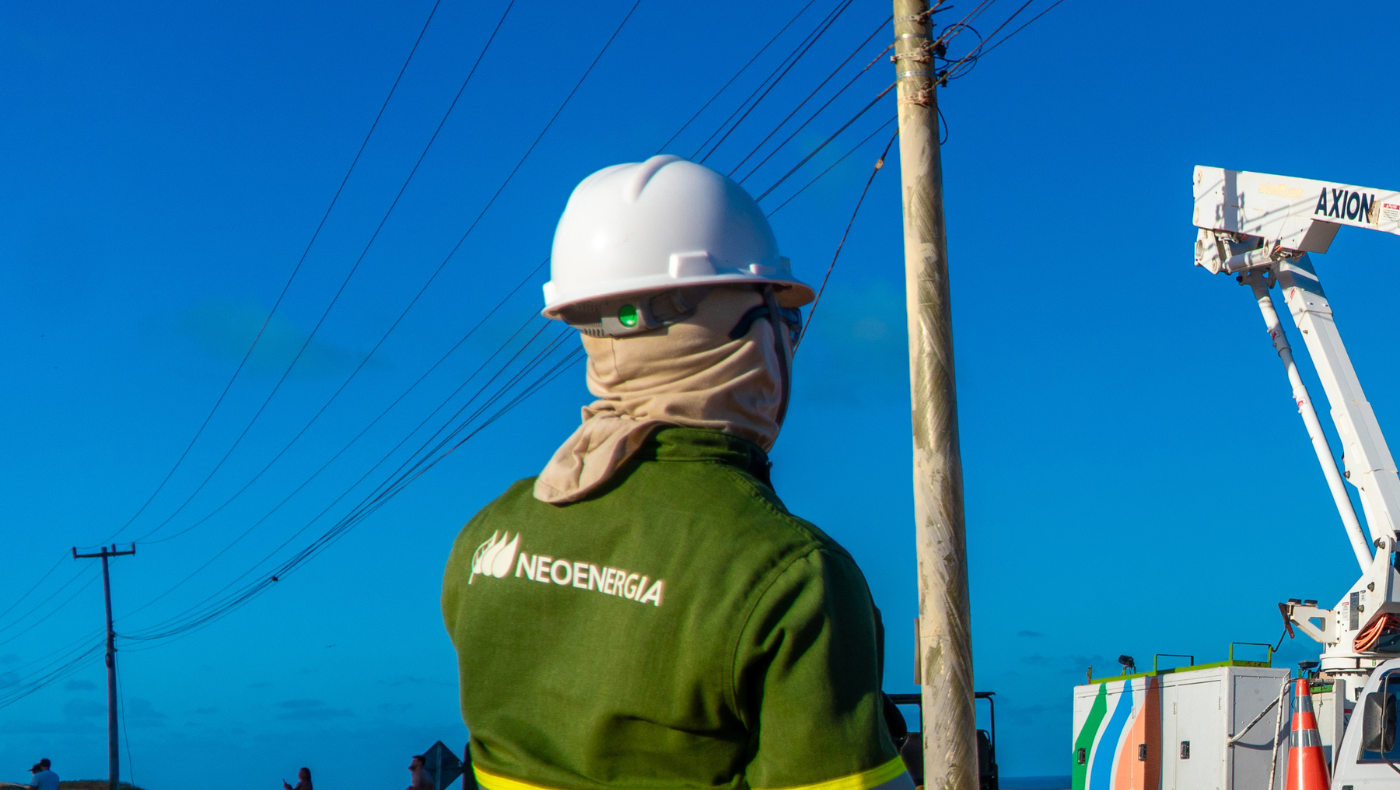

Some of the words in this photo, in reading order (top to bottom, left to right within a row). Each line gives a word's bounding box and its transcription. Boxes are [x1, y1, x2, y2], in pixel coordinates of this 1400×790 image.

[1258, 182, 1303, 199] axionlift.com
[1314, 187, 1375, 223] AXION
[515, 552, 663, 606] NEOENERGIA
